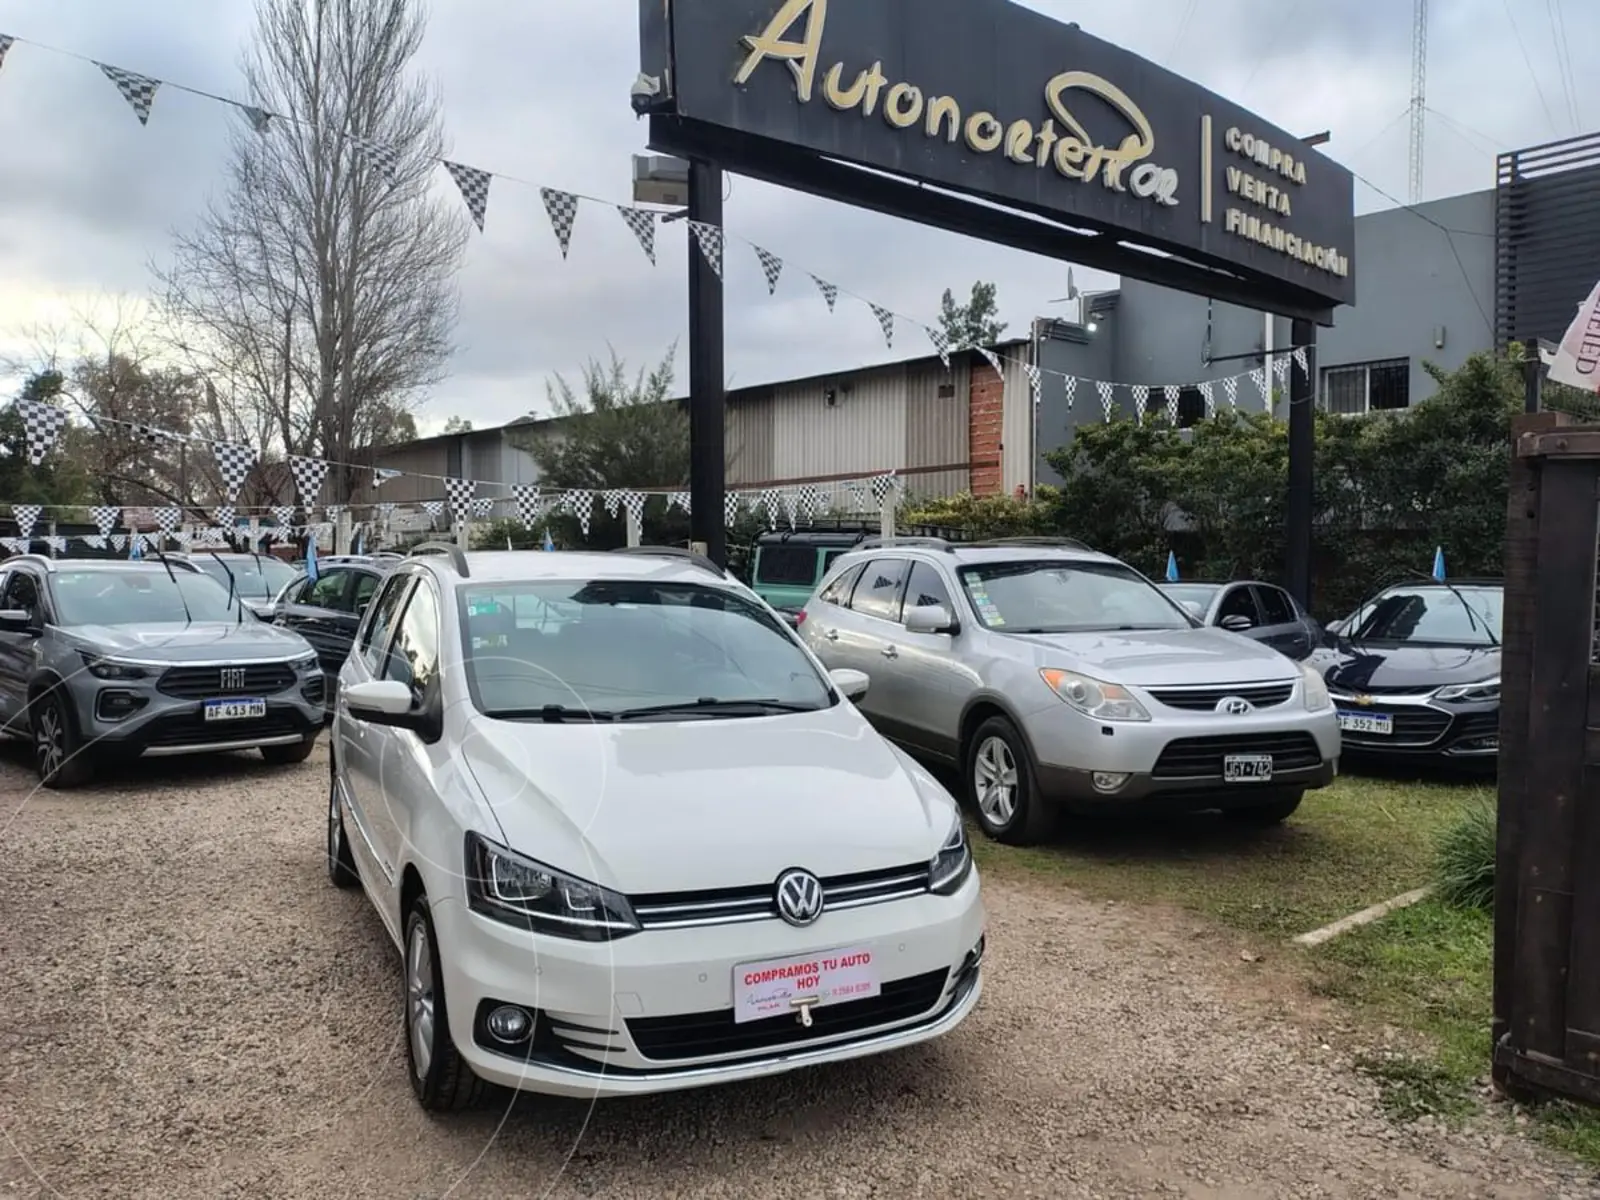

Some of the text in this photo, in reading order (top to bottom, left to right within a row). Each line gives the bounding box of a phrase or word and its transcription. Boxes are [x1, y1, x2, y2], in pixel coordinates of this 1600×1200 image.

[1225, 127, 1306, 184] COMPRA
[1226, 166, 1291, 216] VENTA
[220, 668, 246, 689] FIAT
[207, 705, 222, 718] AF
[225, 703, 247, 716] 413
[1352, 718, 1373, 730] 352
[744, 952, 871, 986] COMPRAMOS TU AUTO
[797, 975, 820, 990] HOY
